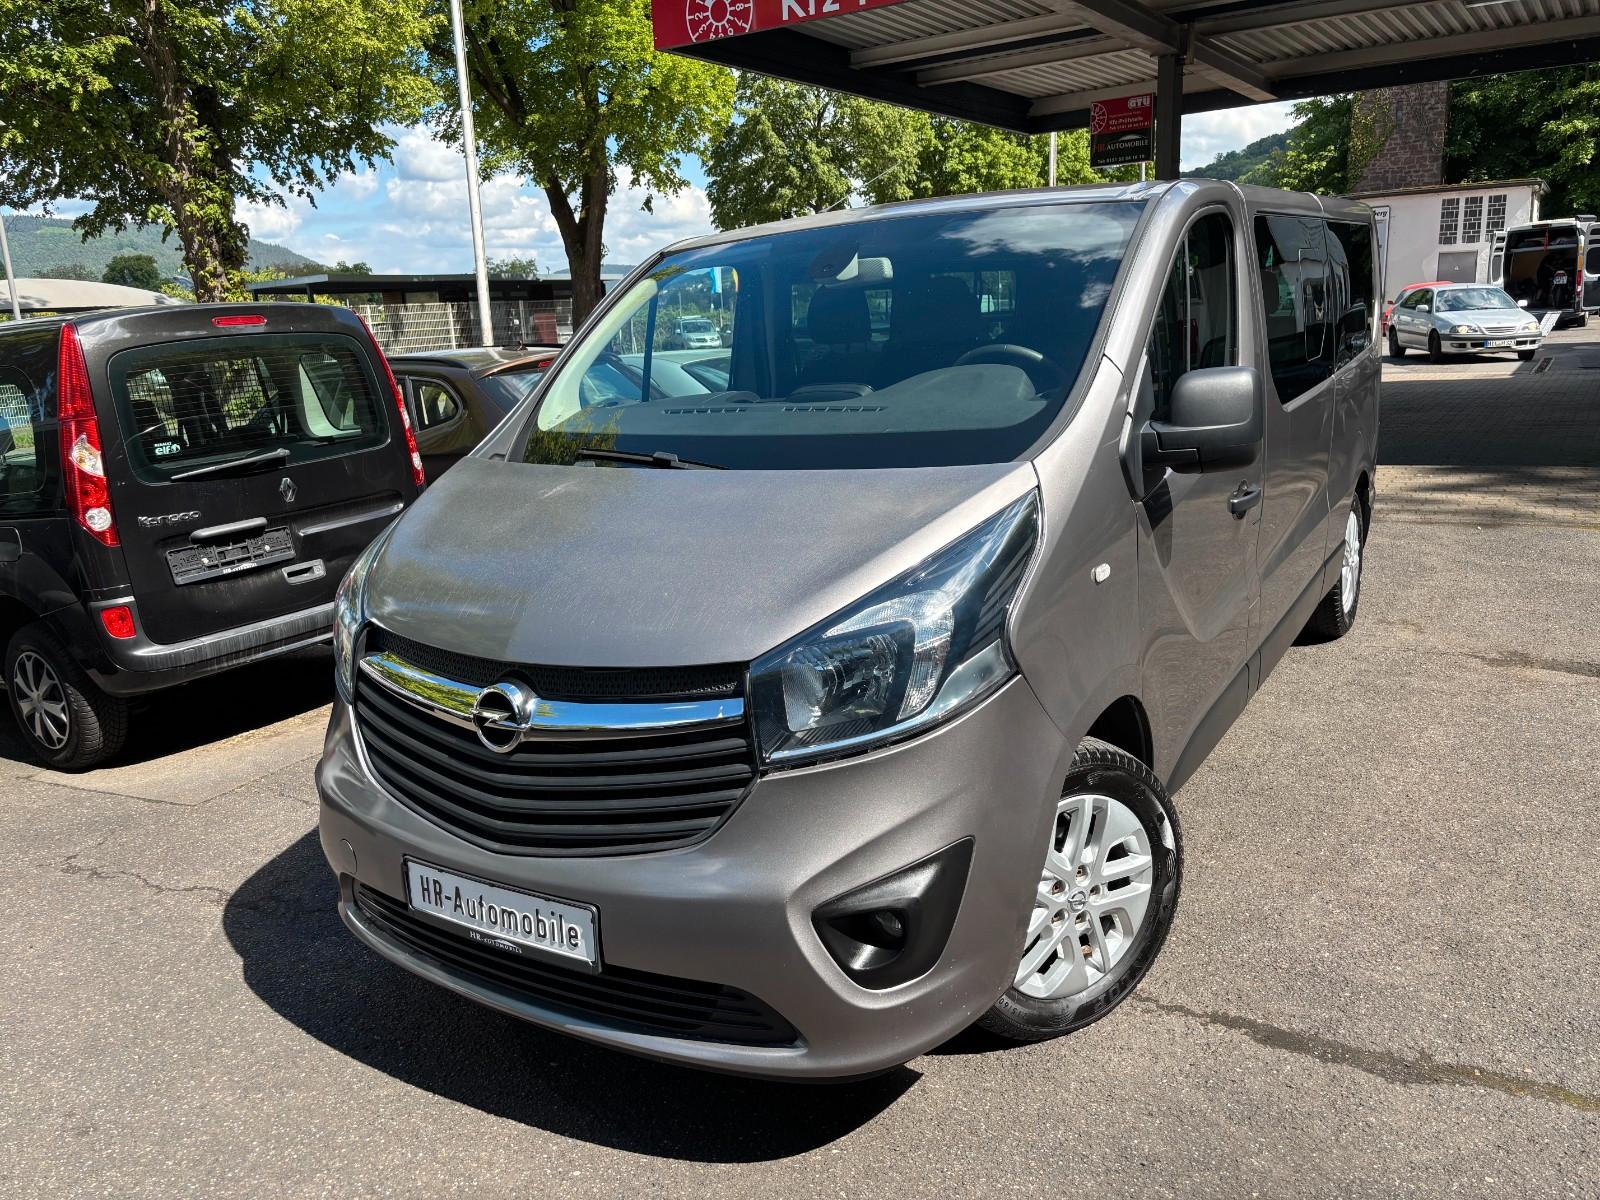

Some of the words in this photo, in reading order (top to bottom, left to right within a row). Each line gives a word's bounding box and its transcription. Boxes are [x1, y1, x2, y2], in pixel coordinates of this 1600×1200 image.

[1107, 140, 1149, 150] AUTOMOBILE
[155, 445, 171, 456] elf
[419, 875, 581, 948] HR-Automobile
